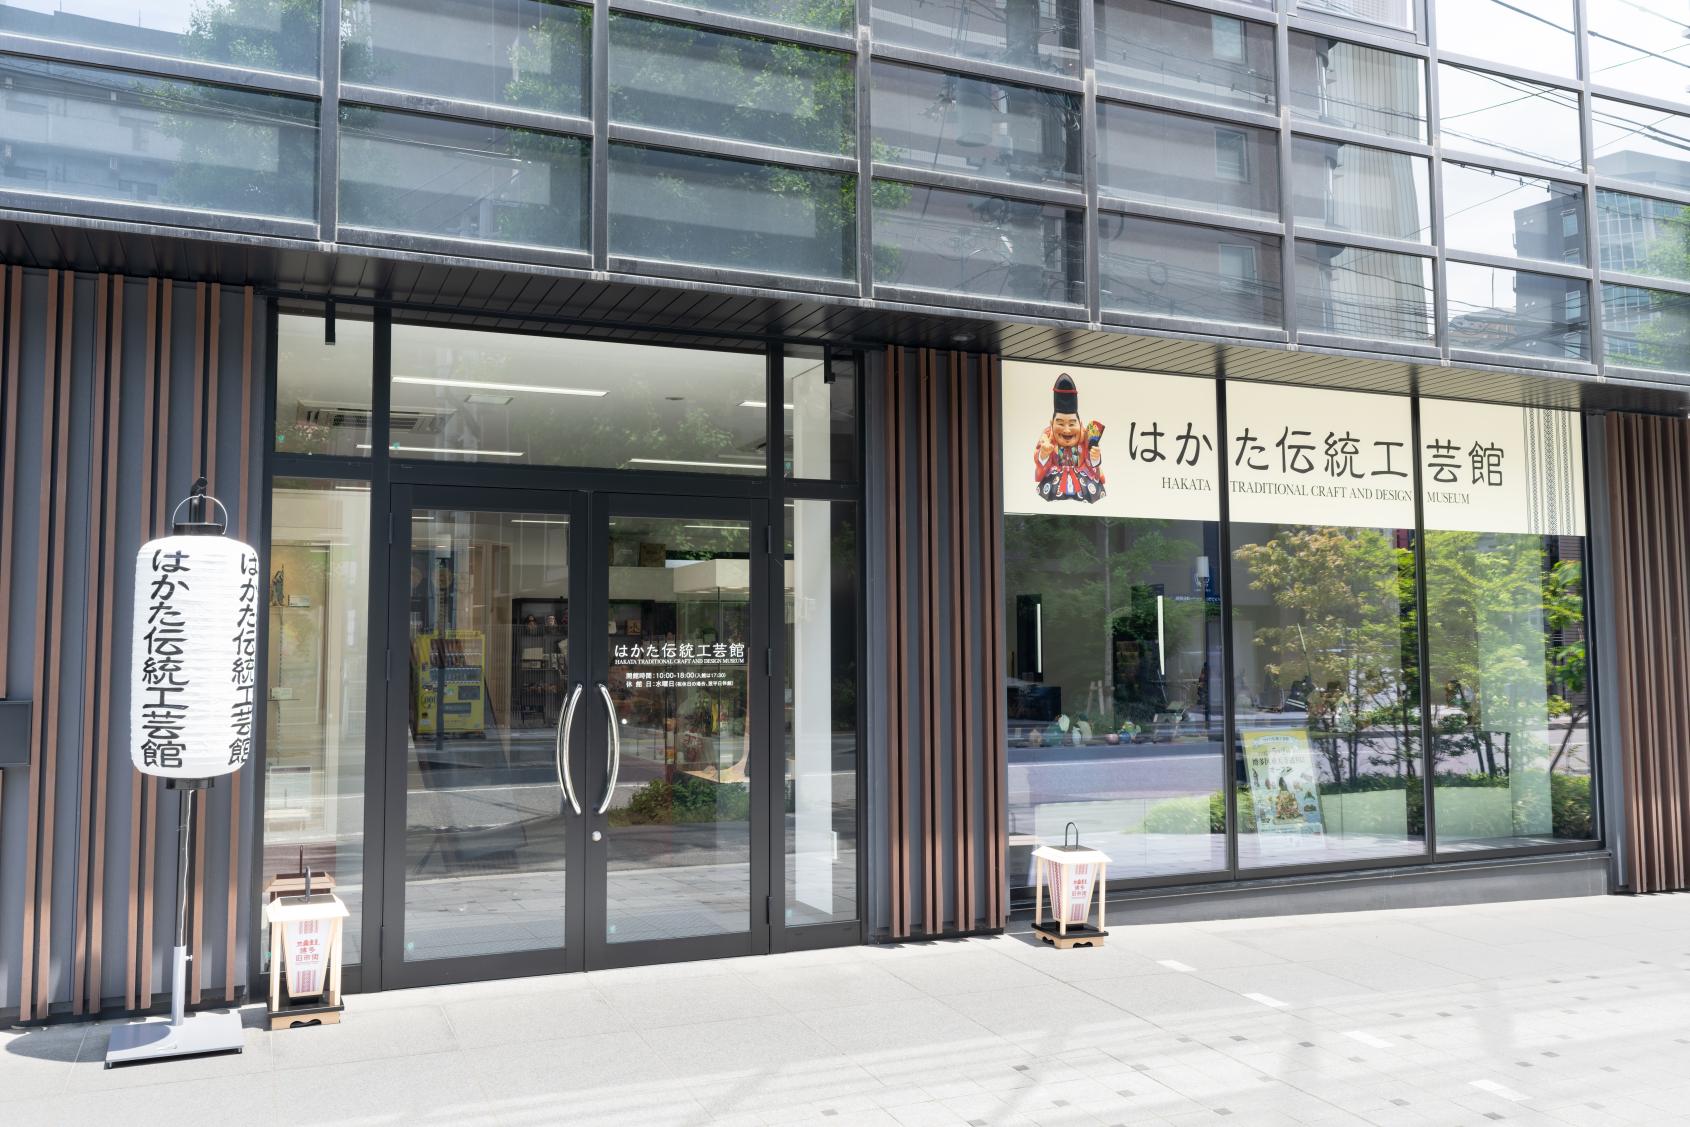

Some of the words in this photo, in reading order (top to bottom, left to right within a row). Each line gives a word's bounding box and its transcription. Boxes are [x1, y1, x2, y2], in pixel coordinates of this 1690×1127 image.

[1129, 421, 1505, 488] はかた伝統工芸館
[1162, 477, 1211, 491] HAKATA
[1230, 481, 1308, 496] TRADITIONAL
[1311, 485, 1347, 498] CRAFT
[1350, 488, 1372, 499] AND
[1375, 489, 1413, 501] DESIGN
[1427, 491, 1470, 504] MUSEUM
[141, 549, 191, 768] はかた伝統工芸館
[614, 643, 744, 657] はかた伝統工芸館
